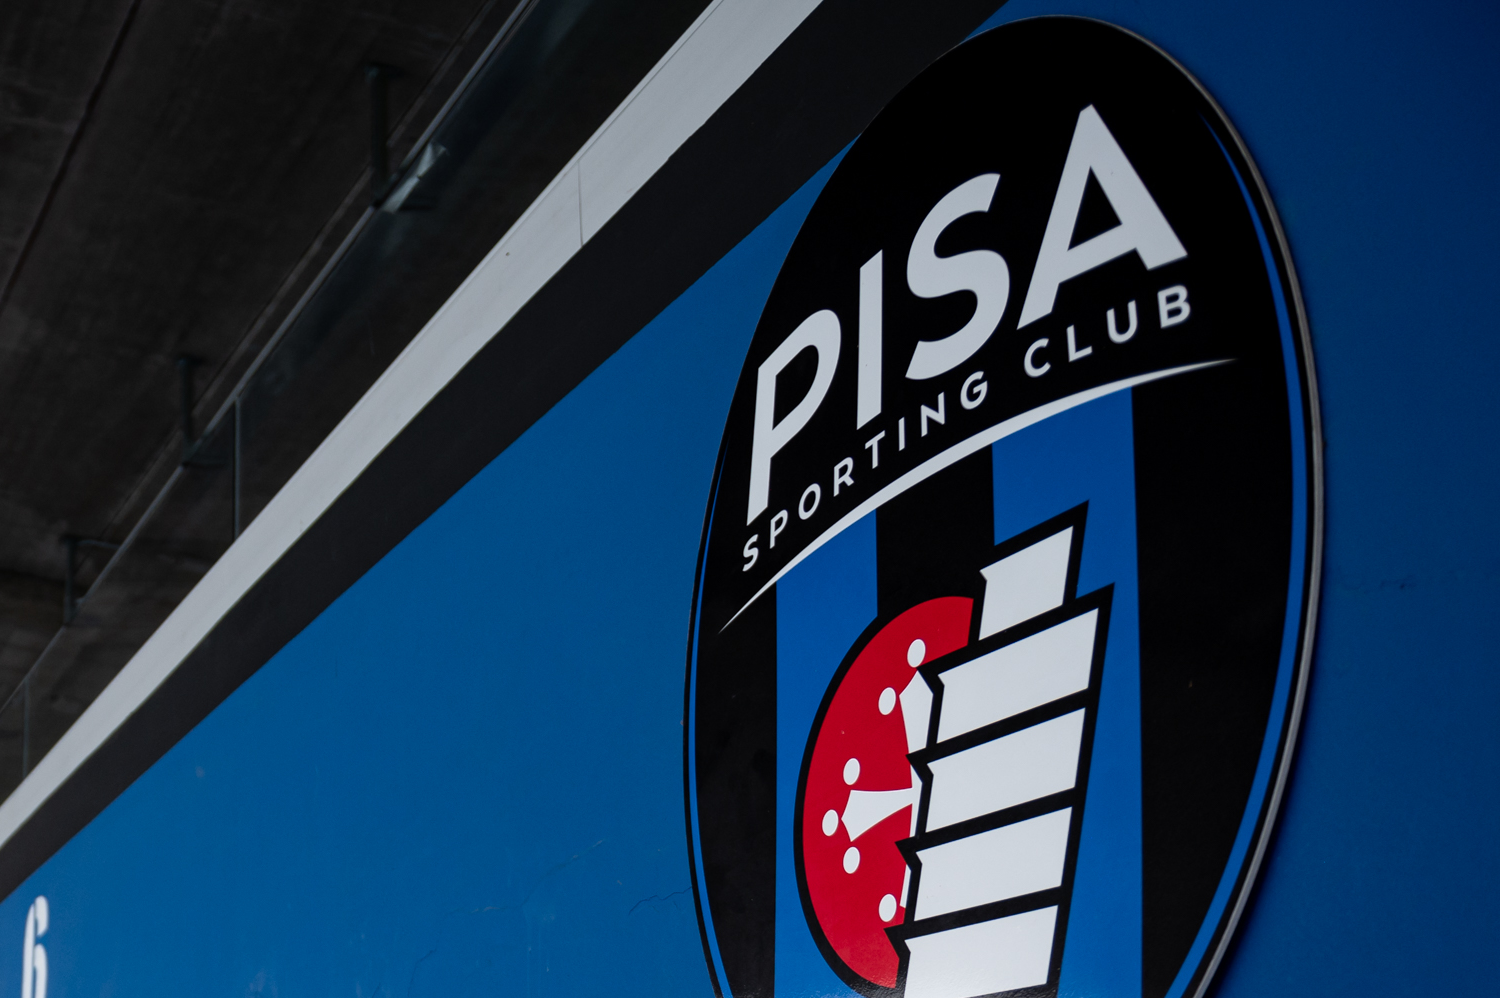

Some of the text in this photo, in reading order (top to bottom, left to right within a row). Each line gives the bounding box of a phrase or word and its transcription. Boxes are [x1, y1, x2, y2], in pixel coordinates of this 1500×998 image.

[742, 284, 1191, 572] SPORTING CLUB
[747, 103, 1187, 526] PISA
